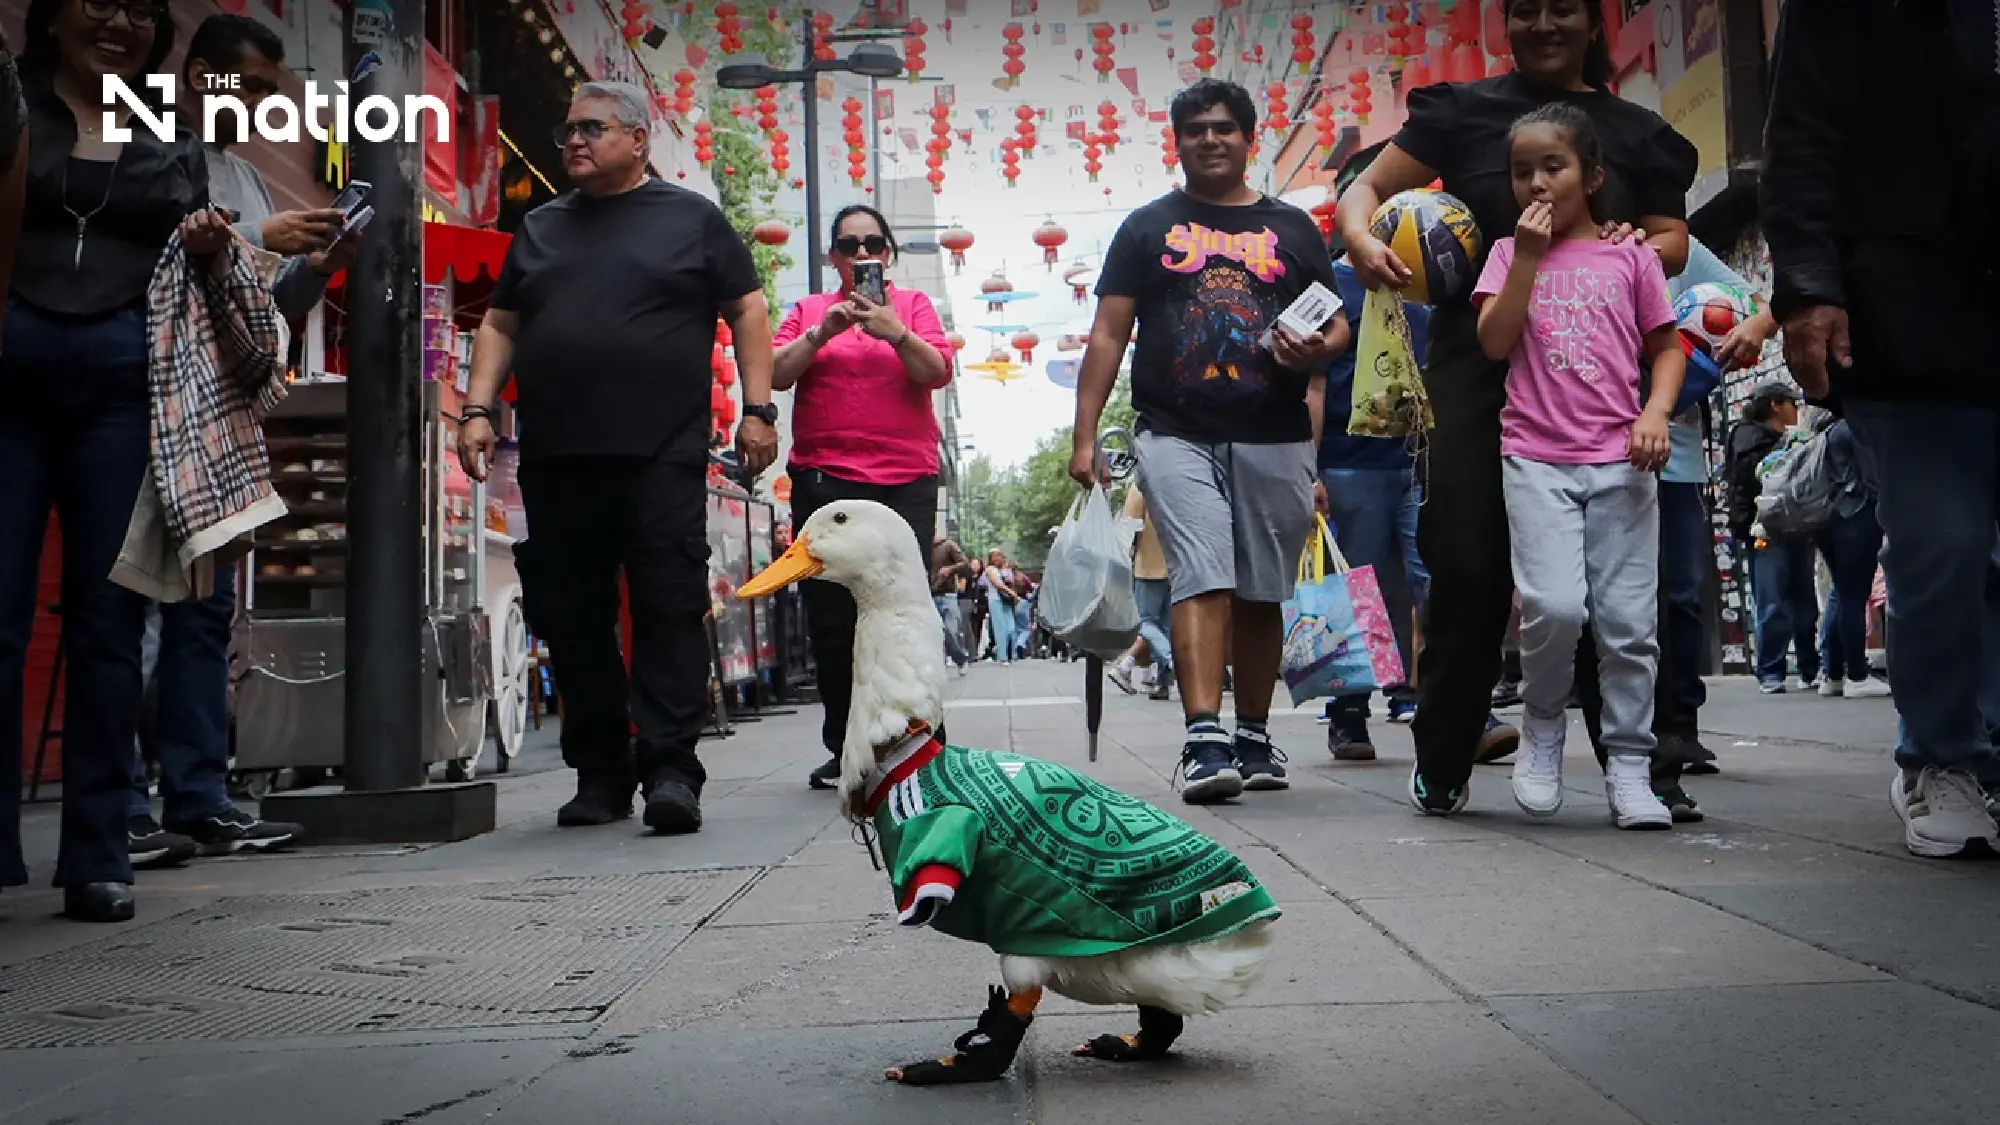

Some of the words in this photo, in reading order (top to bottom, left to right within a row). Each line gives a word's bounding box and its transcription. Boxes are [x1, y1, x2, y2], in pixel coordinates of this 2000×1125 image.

[1537, 270, 1609, 305] JUST
[1551, 303, 1599, 337] DO
[1552, 334, 1596, 371] IT
